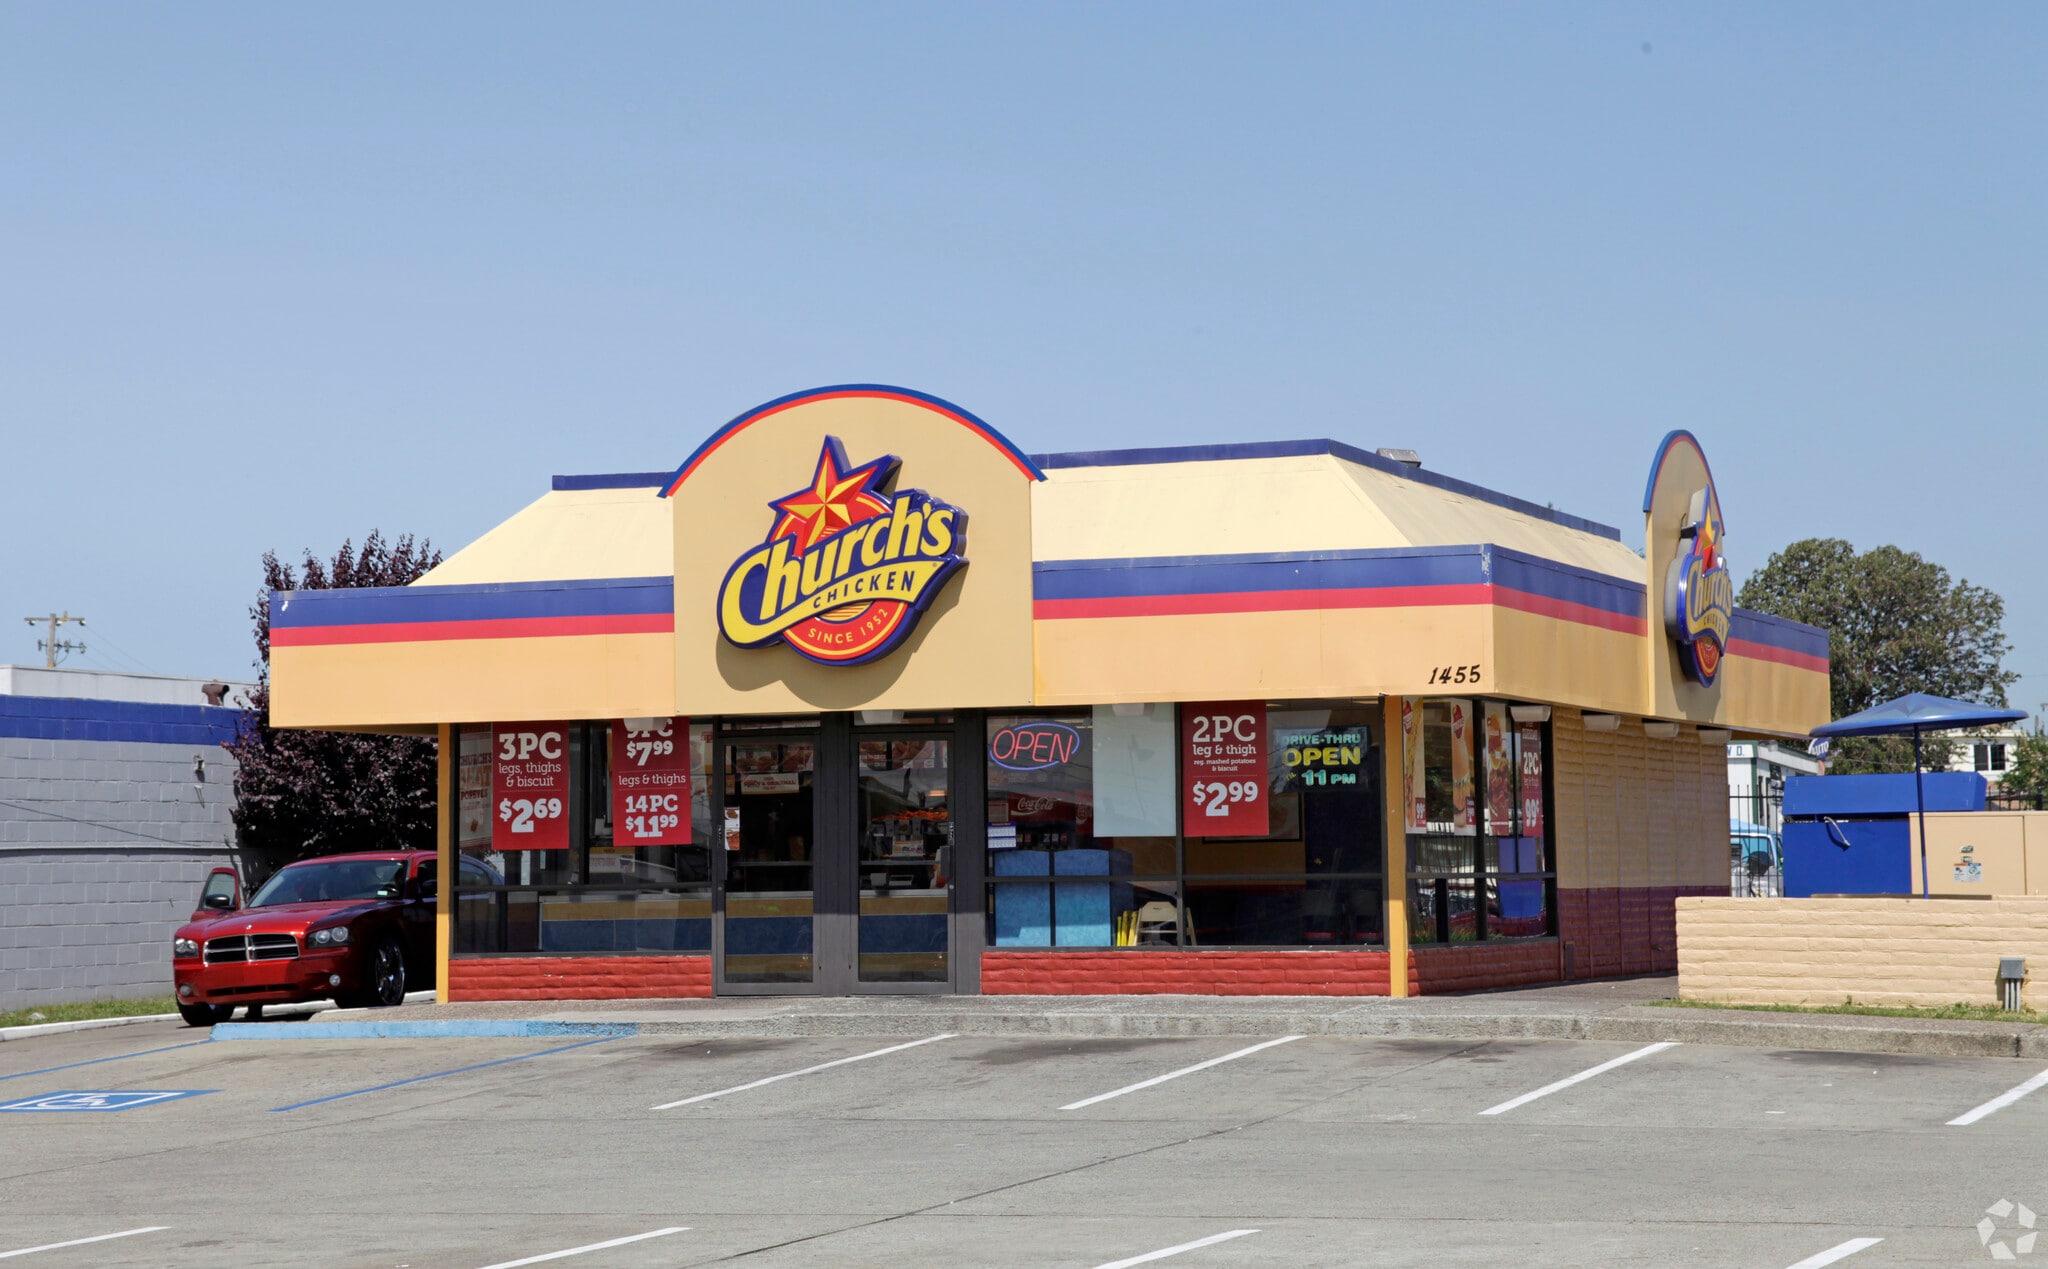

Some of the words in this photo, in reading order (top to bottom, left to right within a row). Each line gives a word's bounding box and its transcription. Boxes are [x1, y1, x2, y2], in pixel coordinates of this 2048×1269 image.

[722, 496, 953, 643] Church's
[813, 570, 915, 608] CHICKEN
[808, 628, 853, 643] SINCE
[860, 608, 888, 636] 1952
[1428, 664, 1481, 684] 1455
[1193, 715, 1256, 742] 2PC
[499, 731, 562, 760] 3PC
[993, 729, 1073, 763] OPEN
[1193, 745, 1212, 757] leg
[1215, 745, 1223, 754] &
[1226, 744, 1257, 756] thigh
[1282, 746, 1360, 766] OPEN
[499, 763, 522, 775] legs,
[526, 762, 561, 774] thighs
[1302, 770, 1327, 786] 11
[1331, 774, 1356, 784] PM
[506, 775, 514, 787] &
[517, 776, 553, 787] biscuit
[619, 776, 640, 787] legs
[643, 774, 650, 784] &
[652, 773, 686, 786] thighs
